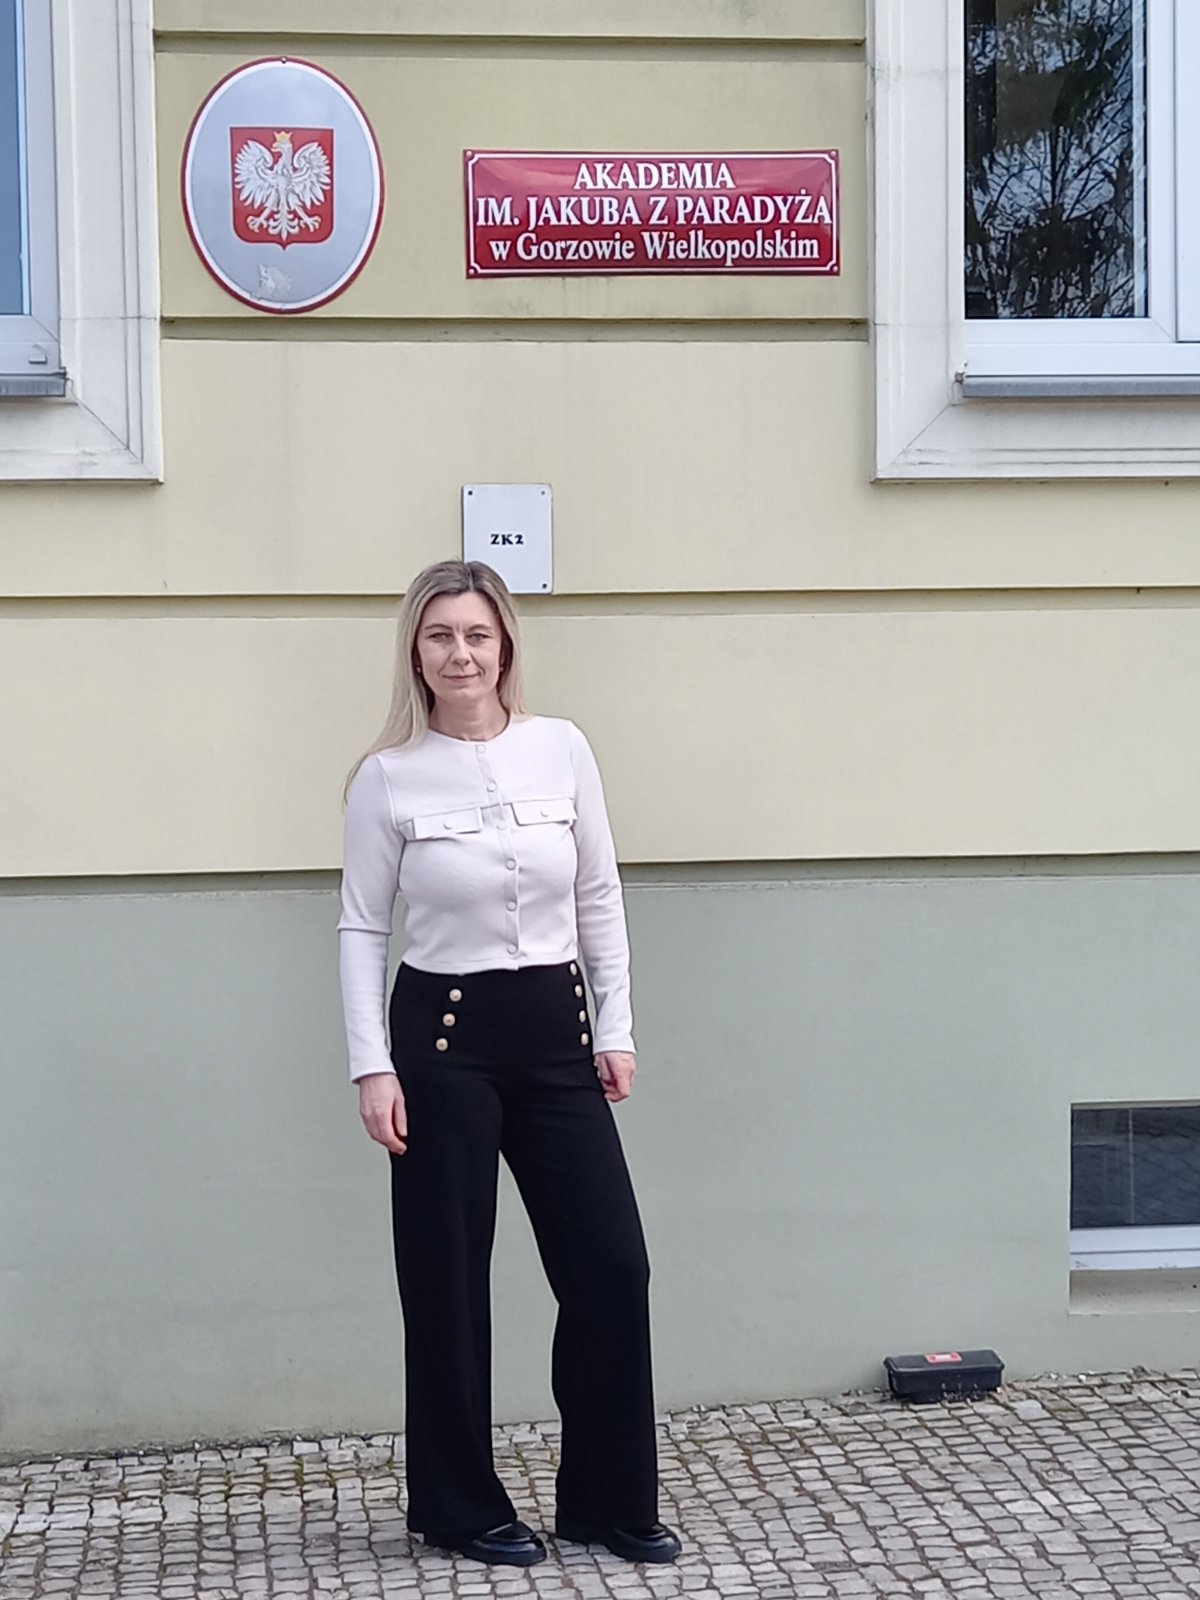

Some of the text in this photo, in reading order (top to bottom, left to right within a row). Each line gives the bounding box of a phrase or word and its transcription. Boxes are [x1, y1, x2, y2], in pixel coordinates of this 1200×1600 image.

[573, 161, 736, 190] AKADEMIA
[476, 188, 833, 231] IM. JAKUBA Z PARADYŻA
[489, 229, 820, 266] w Gorzowie Wielkopolskim
[490, 533, 524, 545] ZK2
